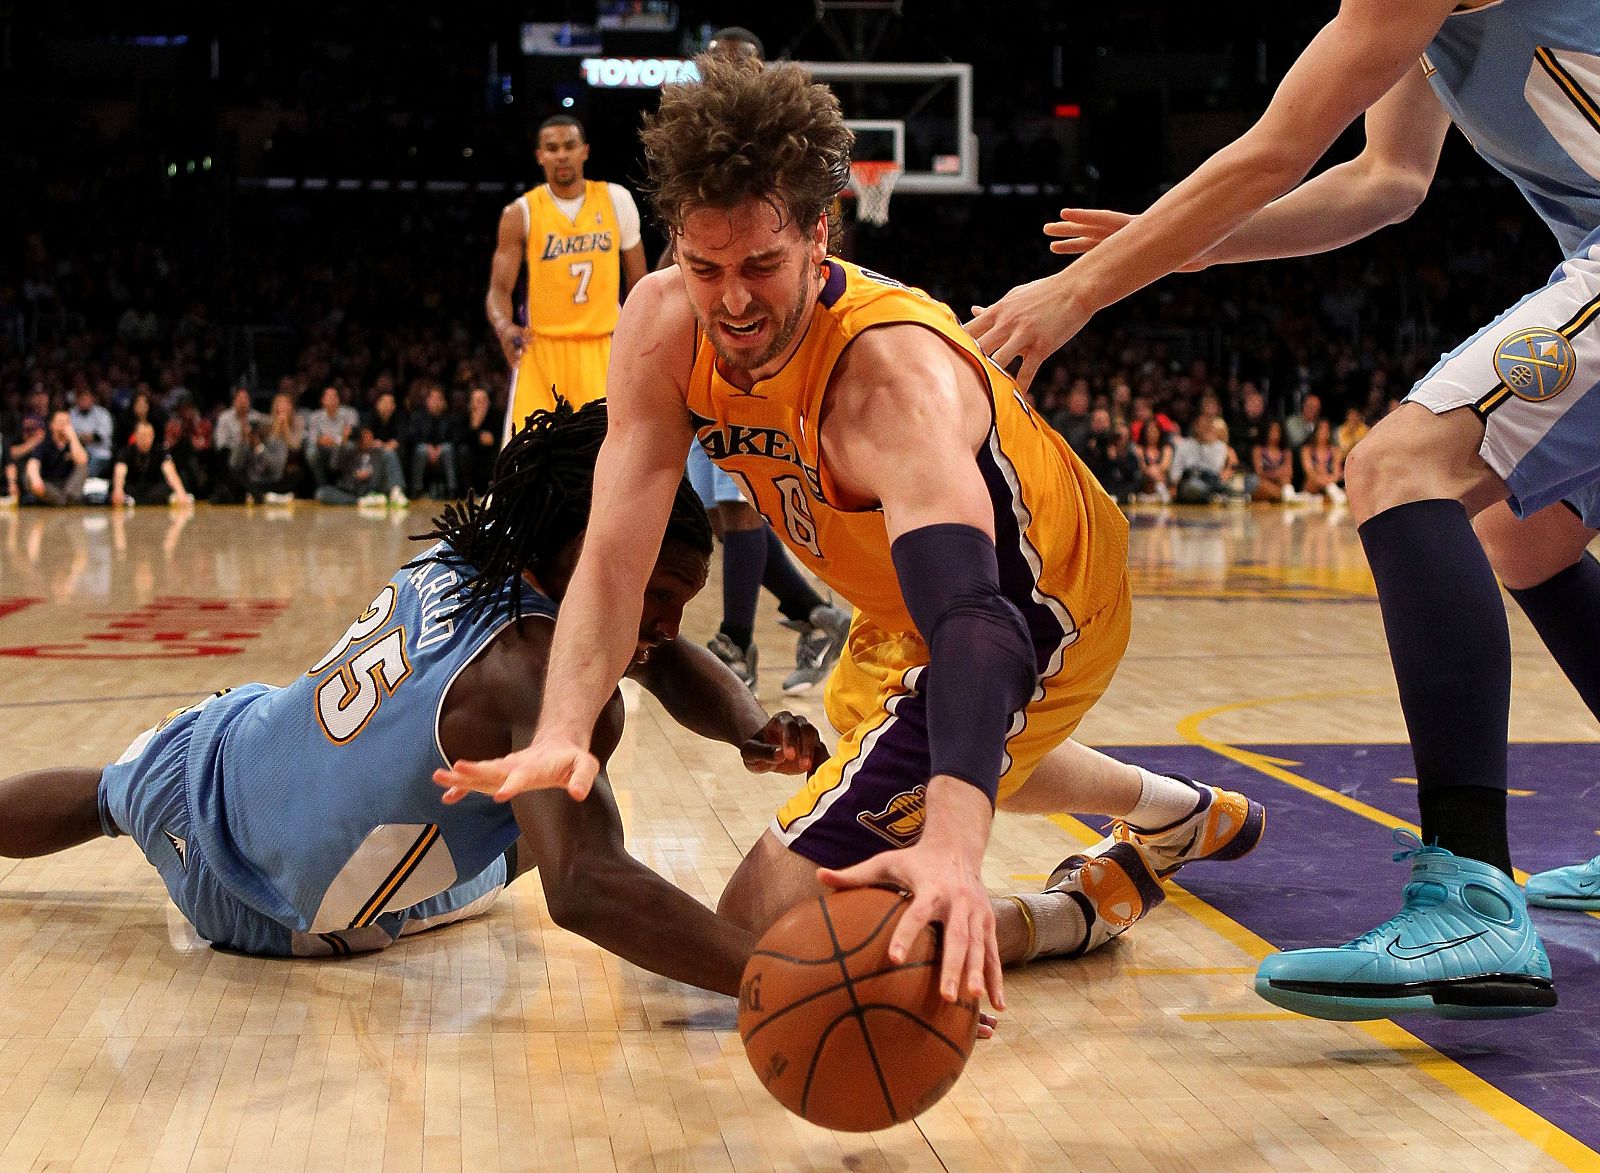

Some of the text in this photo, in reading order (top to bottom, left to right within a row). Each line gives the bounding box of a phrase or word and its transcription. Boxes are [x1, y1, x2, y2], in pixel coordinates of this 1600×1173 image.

[580, 57, 702, 87] TOYOTA
[541, 231, 613, 261] LAKERS
[569, 261, 594, 304] 7
[306, 582, 414, 746] 35
